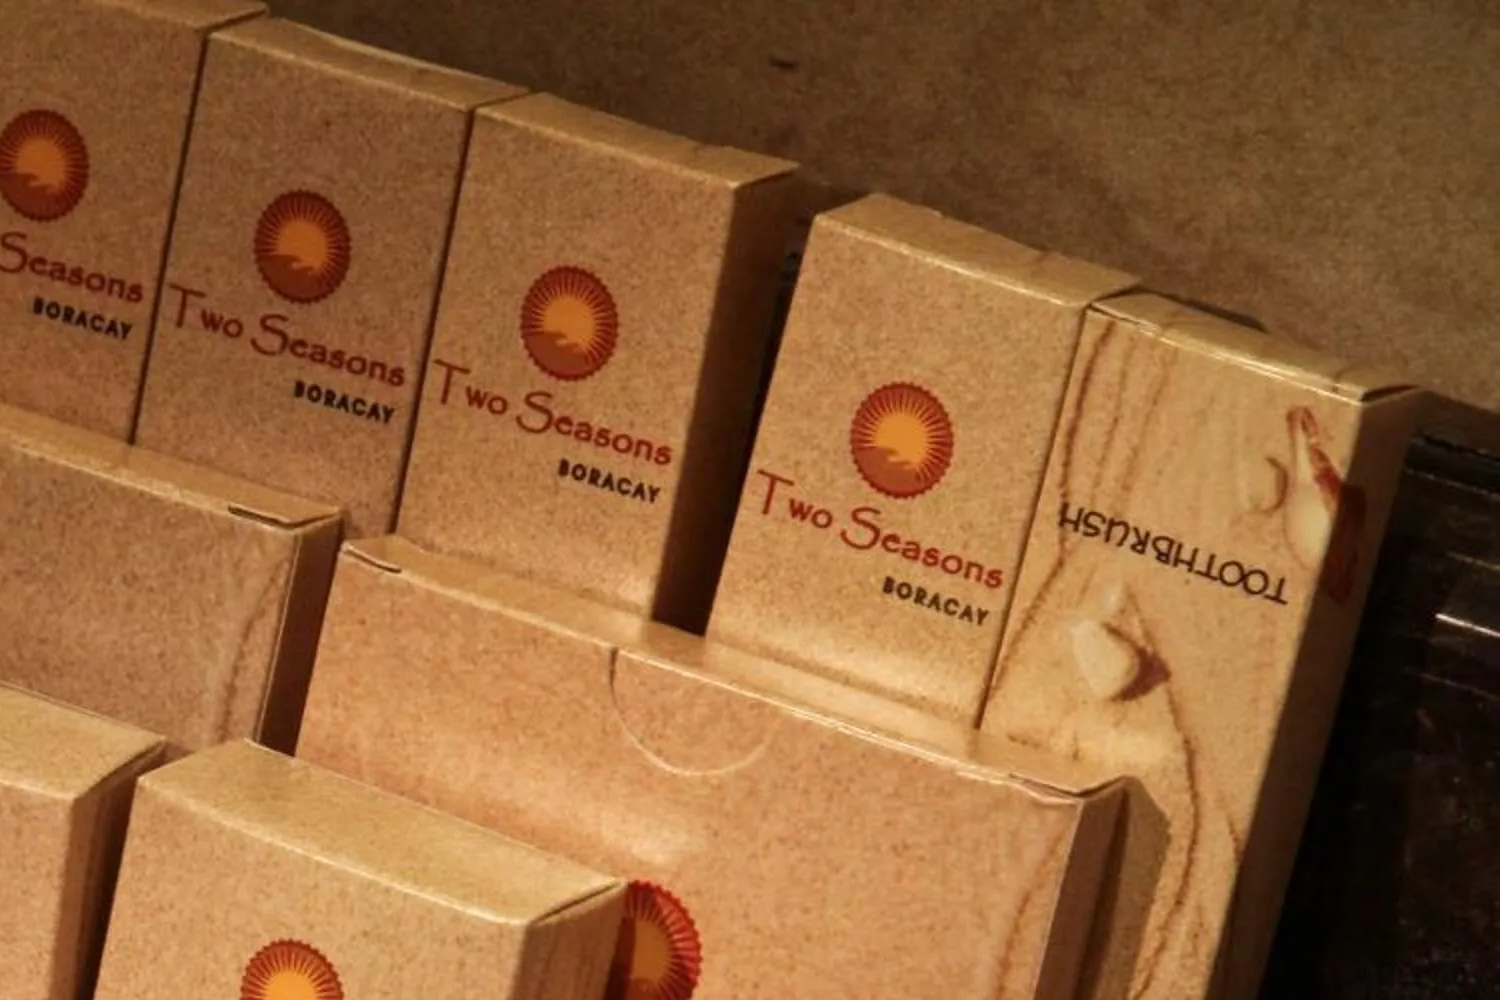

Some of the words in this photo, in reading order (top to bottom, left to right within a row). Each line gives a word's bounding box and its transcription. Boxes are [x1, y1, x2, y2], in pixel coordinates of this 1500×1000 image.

[33, 297, 134, 341] BORACAY
[169, 282, 243, 339] Two
[250, 314, 405, 387] Seasons
[294, 380, 395, 425] BORACAY
[434, 358, 507, 417] Two
[516, 391, 671, 466] Seasons
[558, 459, 660, 504] BORACAY
[756, 469, 833, 530] Two
[840, 506, 1004, 589] Seasons
[1058, 502, 1289, 605] TOOTHBRUSH
[882, 576, 990, 626] BORACAY
